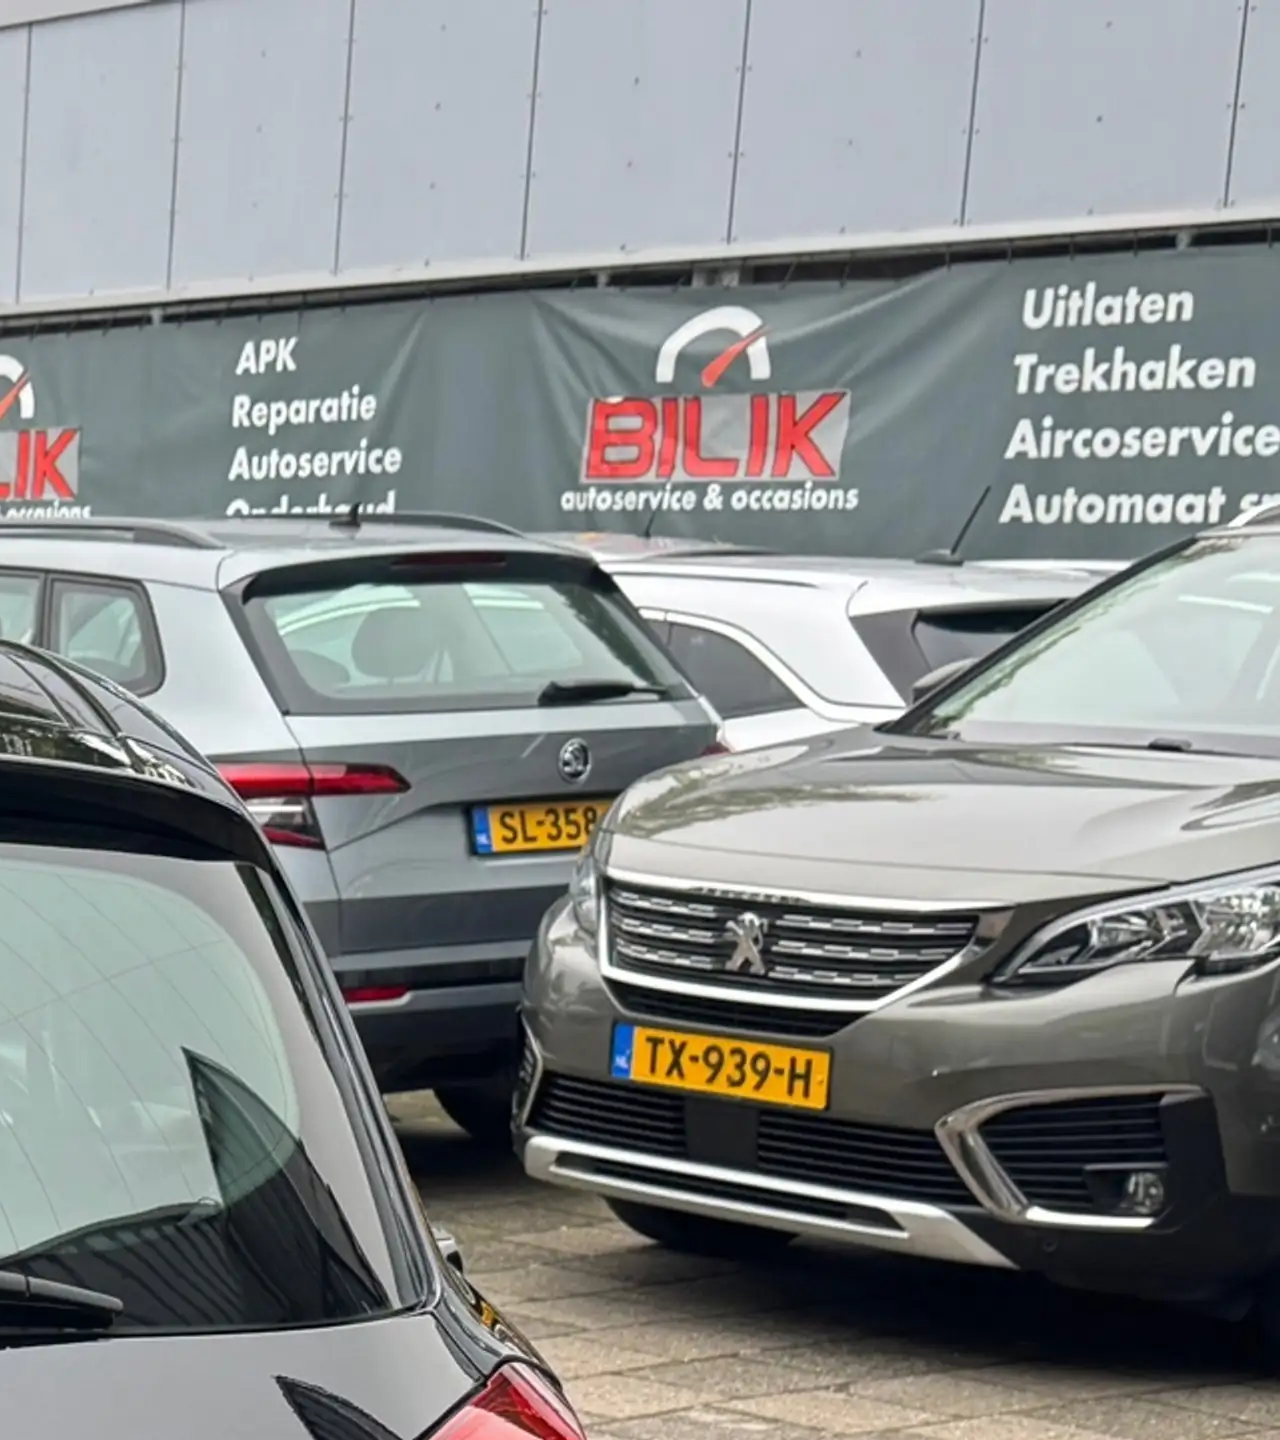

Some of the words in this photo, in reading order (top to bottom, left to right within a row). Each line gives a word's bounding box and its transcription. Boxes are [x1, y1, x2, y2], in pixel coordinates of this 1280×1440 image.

[1022, 281, 1195, 330] Uitlaten
[235, 336, 299, 375] APK
[1014, 344, 1257, 394] Trekhaken
[232, 384, 378, 436] Reparatie
[1003, 410, 1280, 459] Aircoservice
[228, 437, 403, 481] Autoservice
[585, 391, 847, 479] BILIK
[560, 484, 697, 511] autoservice
[703, 482, 724, 511] &
[730, 479, 860, 511] occasions
[998, 484, 1227, 524] Automaat
[645, 1036, 813, 1098] TX-939-H
